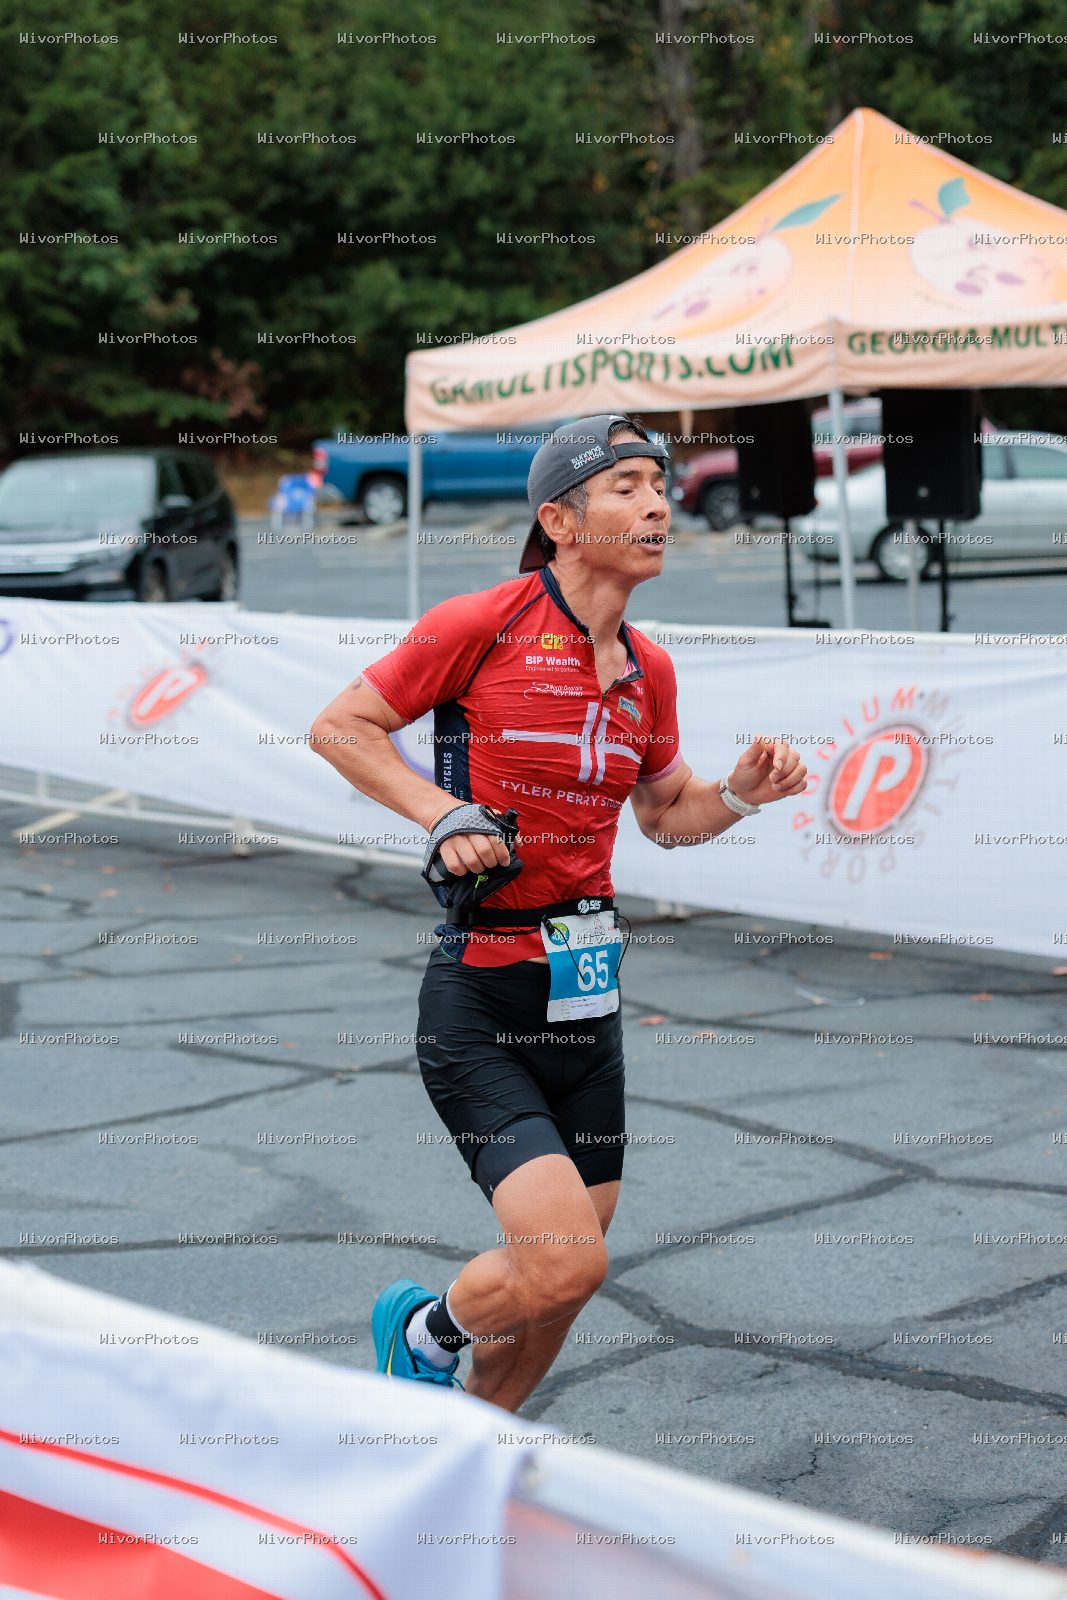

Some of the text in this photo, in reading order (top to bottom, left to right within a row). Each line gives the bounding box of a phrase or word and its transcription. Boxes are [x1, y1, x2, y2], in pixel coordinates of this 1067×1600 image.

[847, 325, 984, 356] GEORGIA
[525, 655, 581, 667] BIP Wealth
[138, 669, 199, 717] P
[500, 780, 551, 799] TYLER
[556, 791, 598, 807] PERRY
[842, 739, 913, 821] P
[577, 949, 609, 992] 65
